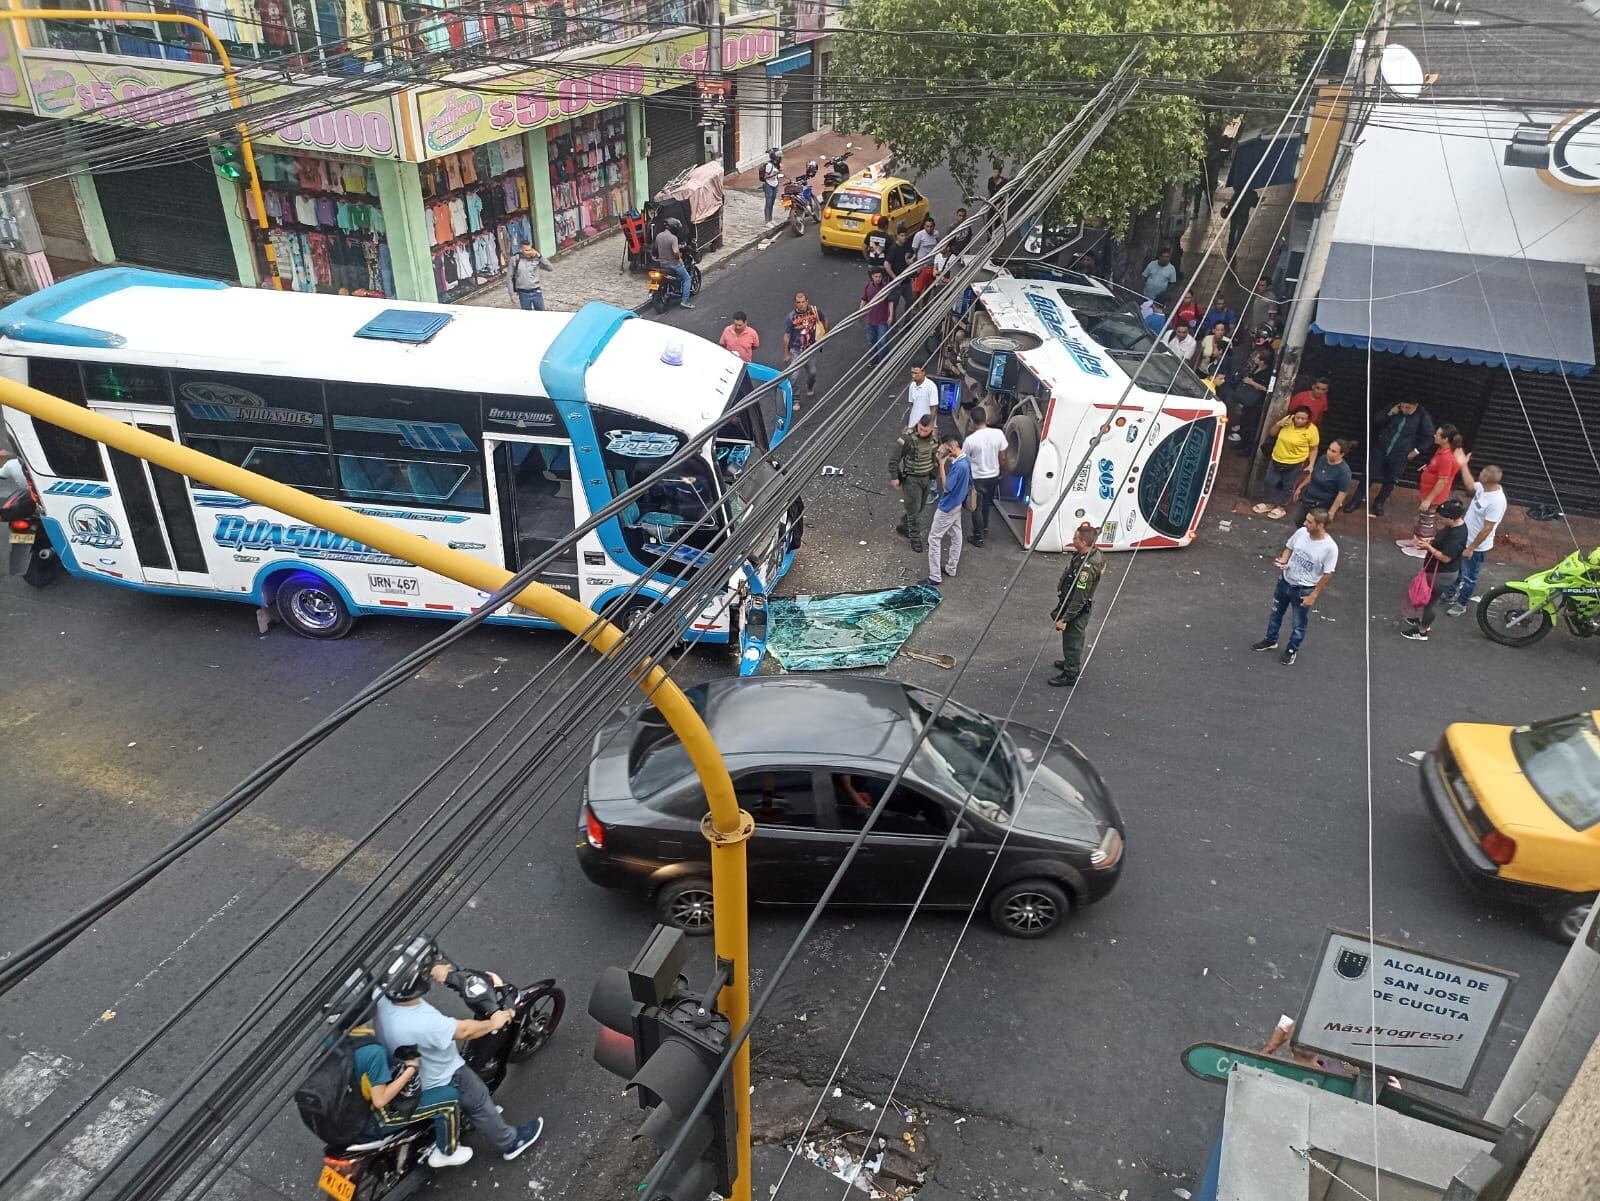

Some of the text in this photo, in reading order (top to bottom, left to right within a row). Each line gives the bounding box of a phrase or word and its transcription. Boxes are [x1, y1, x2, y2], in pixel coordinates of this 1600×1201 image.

[489, 61, 645, 130] $5.000
[212, 513, 380, 552] GUASIMA
[1383, 958, 1490, 992] ALCALDIA DE
[1383, 976, 1471, 1005] SAN JOSE
[1373, 989, 1470, 1022] DE CUCUTA
[1323, 1022, 1464, 1042] Más Progreso!
